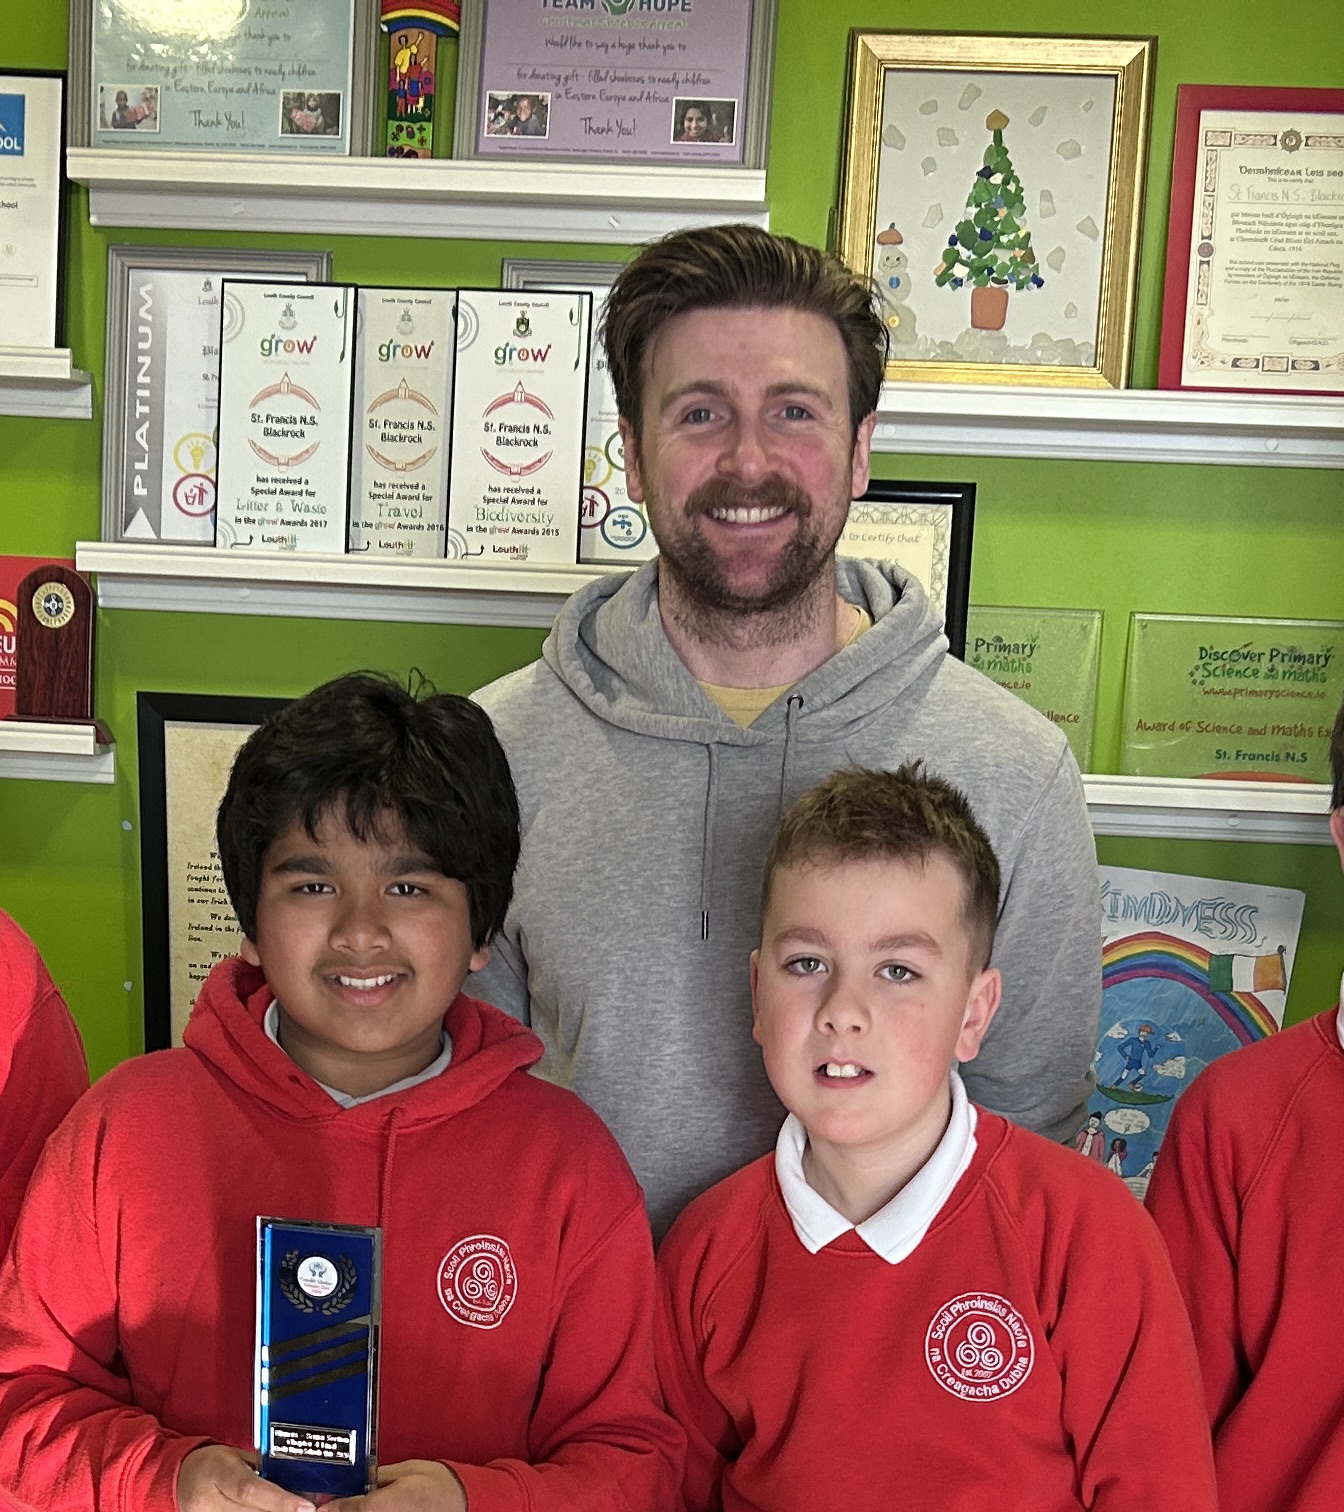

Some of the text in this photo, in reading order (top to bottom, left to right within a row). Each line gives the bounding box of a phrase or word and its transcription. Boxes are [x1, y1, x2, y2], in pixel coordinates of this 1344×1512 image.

[580, 117, 636, 138] Thank You!
[260, 334, 317, 357] grow
[378, 339, 434, 362] grow
[495, 342, 551, 365] grow
[134, 283, 152, 496] PLATINUM
[251, 414, 318, 426] St. Francis N.S.
[484, 423, 551, 435] St. Francis N.S.
[263, 426, 305, 438] Blackrock
[496, 436, 538, 447] Blackrock
[236, 499, 327, 515] Litter & Waste
[378, 502, 423, 518] Travel
[473, 504, 554, 523] Biodiversity
[1199, 647, 1333, 667] Discover Primary
[1202, 663, 1327, 683] Science maths
[1203, 687, 1326, 700] www.primaryscience.ie
[1136, 719, 1175, 732] Award
[1180, 722, 1192, 731] of
[1196, 721, 1241, 735] Science
[1247, 724, 1266, 736] and
[1216, 749, 1307, 762] St. Francis N.S
[932, 1296, 1028, 1348] Scoil Phroinsias Naofa
[930, 1348, 1028, 1396] na Creagacha Dubha
